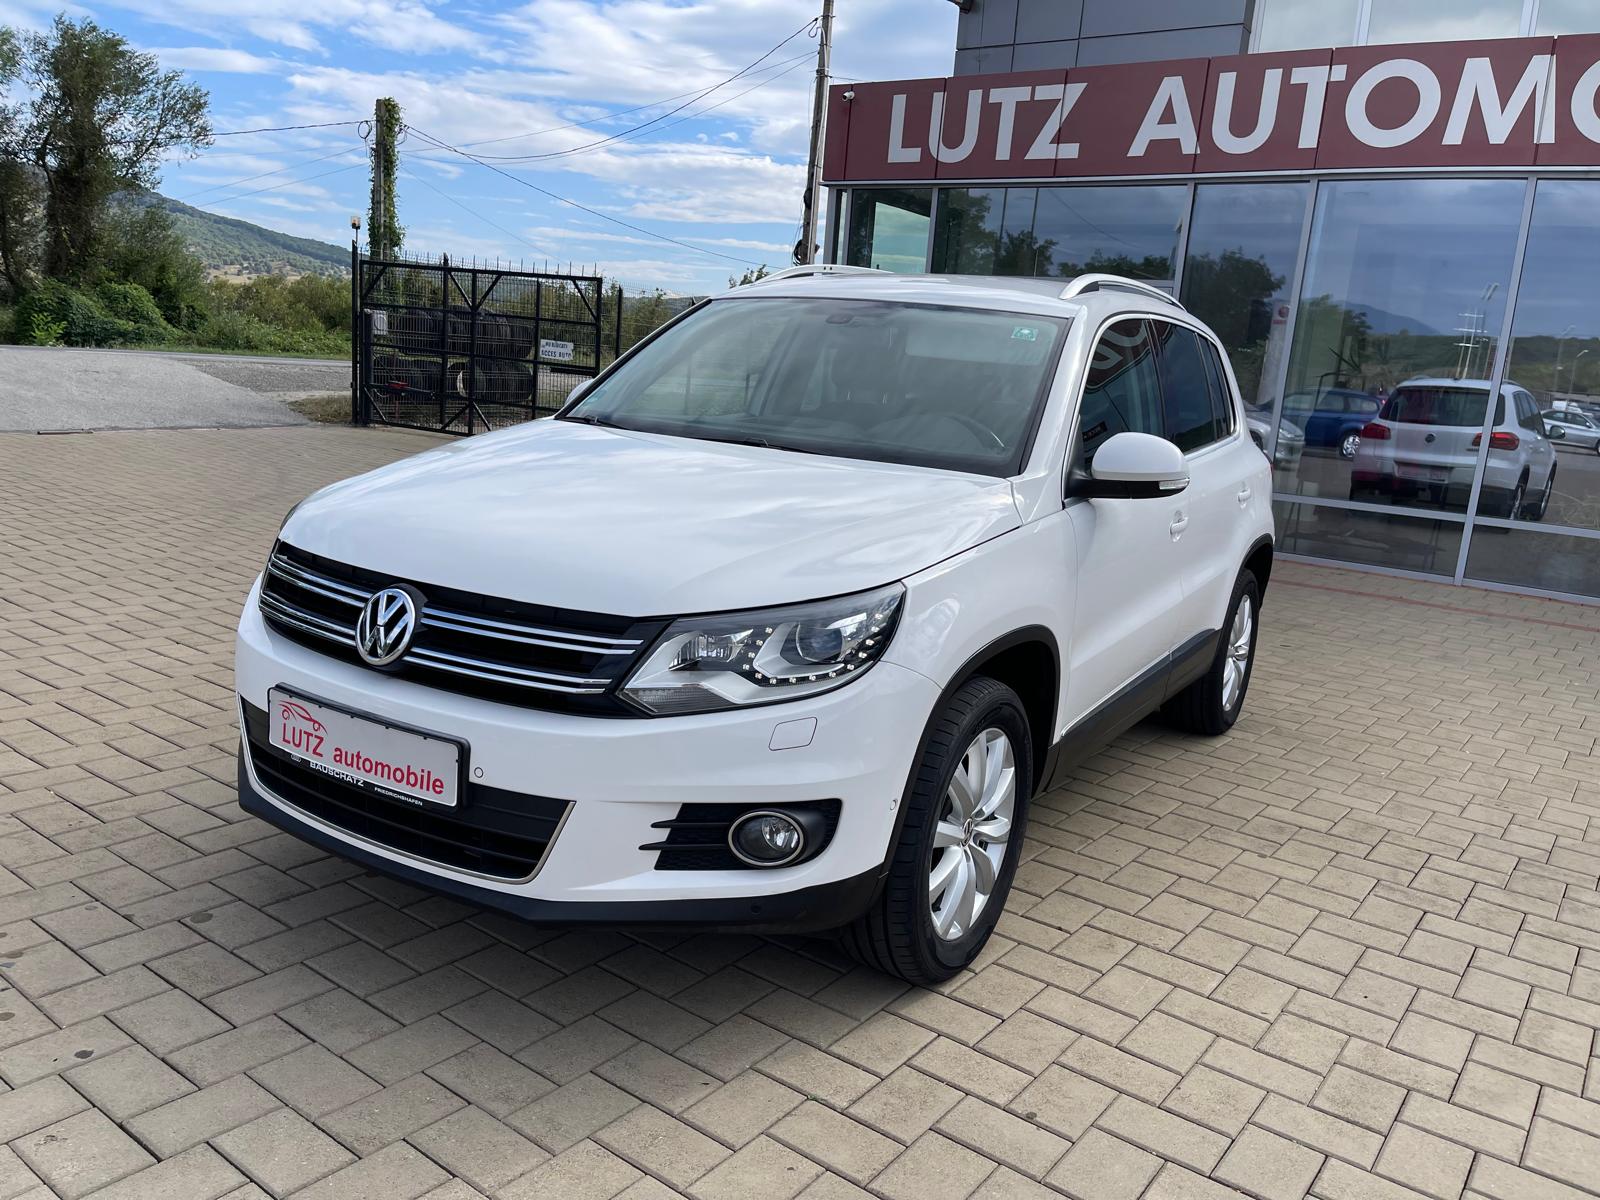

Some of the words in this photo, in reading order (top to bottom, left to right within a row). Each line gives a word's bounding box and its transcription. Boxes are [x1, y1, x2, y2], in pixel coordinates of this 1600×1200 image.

[886, 81, 1088, 164] LUTZ
[357, 588, 416, 666] VW
[281, 722, 325, 757] LUTZ
[332, 746, 445, 795] automobile
[309, 760, 364, 787] BAUSCHATZ
